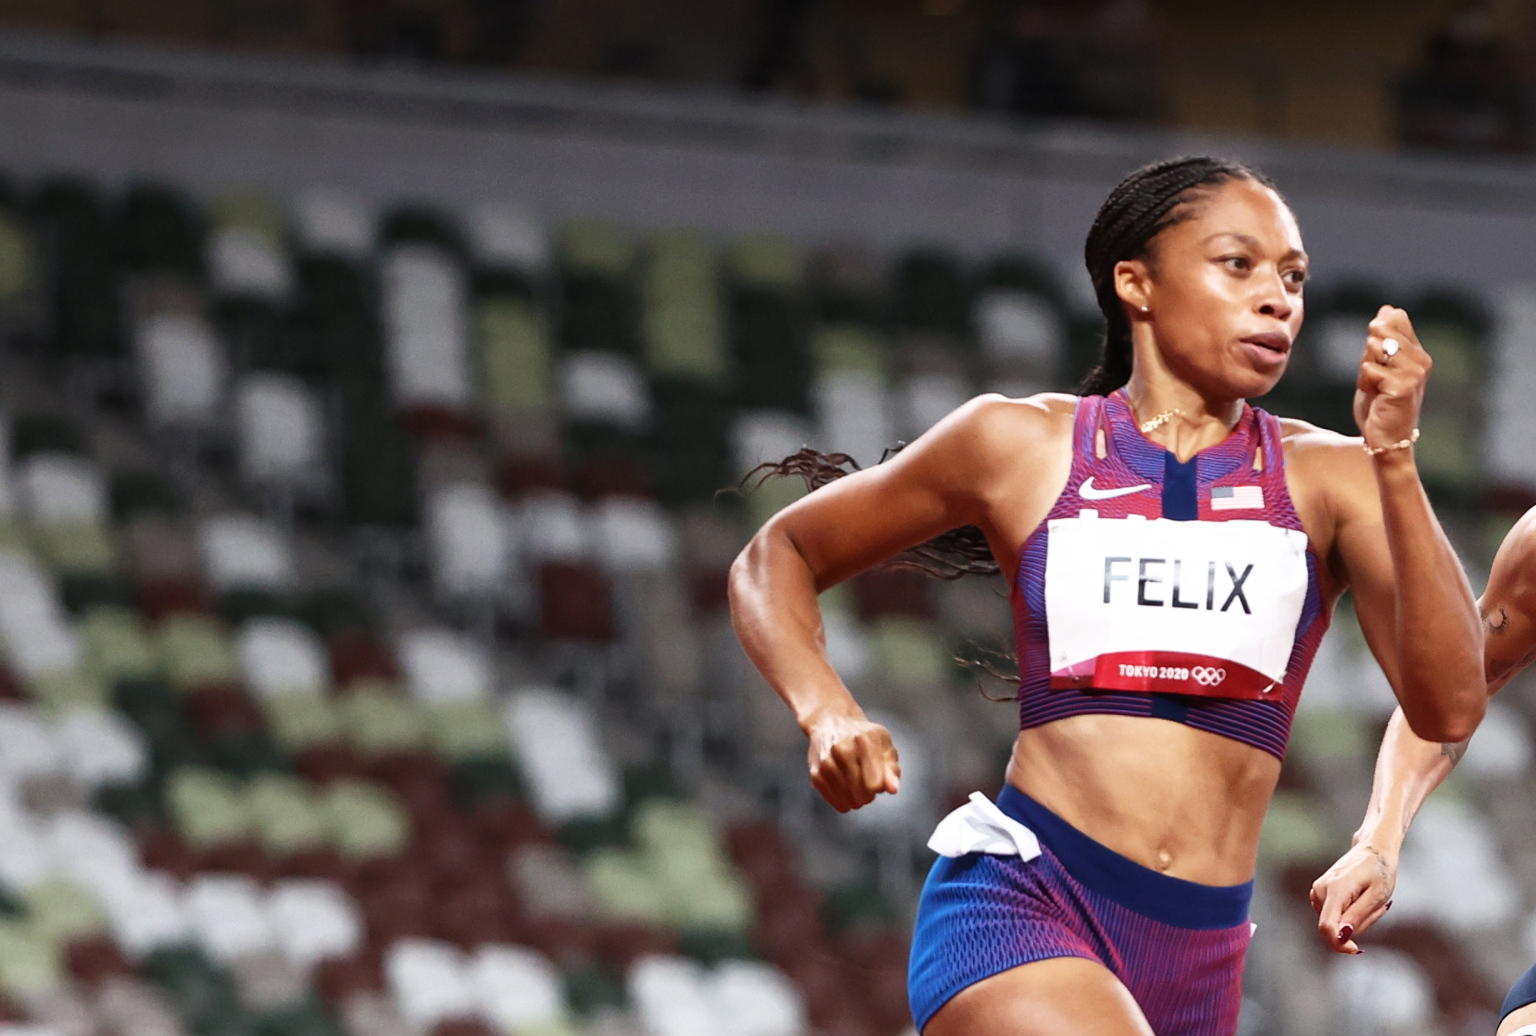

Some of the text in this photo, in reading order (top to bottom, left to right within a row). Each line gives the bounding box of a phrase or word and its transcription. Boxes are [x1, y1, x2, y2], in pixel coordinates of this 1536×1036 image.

[1102, 556, 1255, 615] FELIX
[1118, 664, 1190, 681] TOKYO 2020
